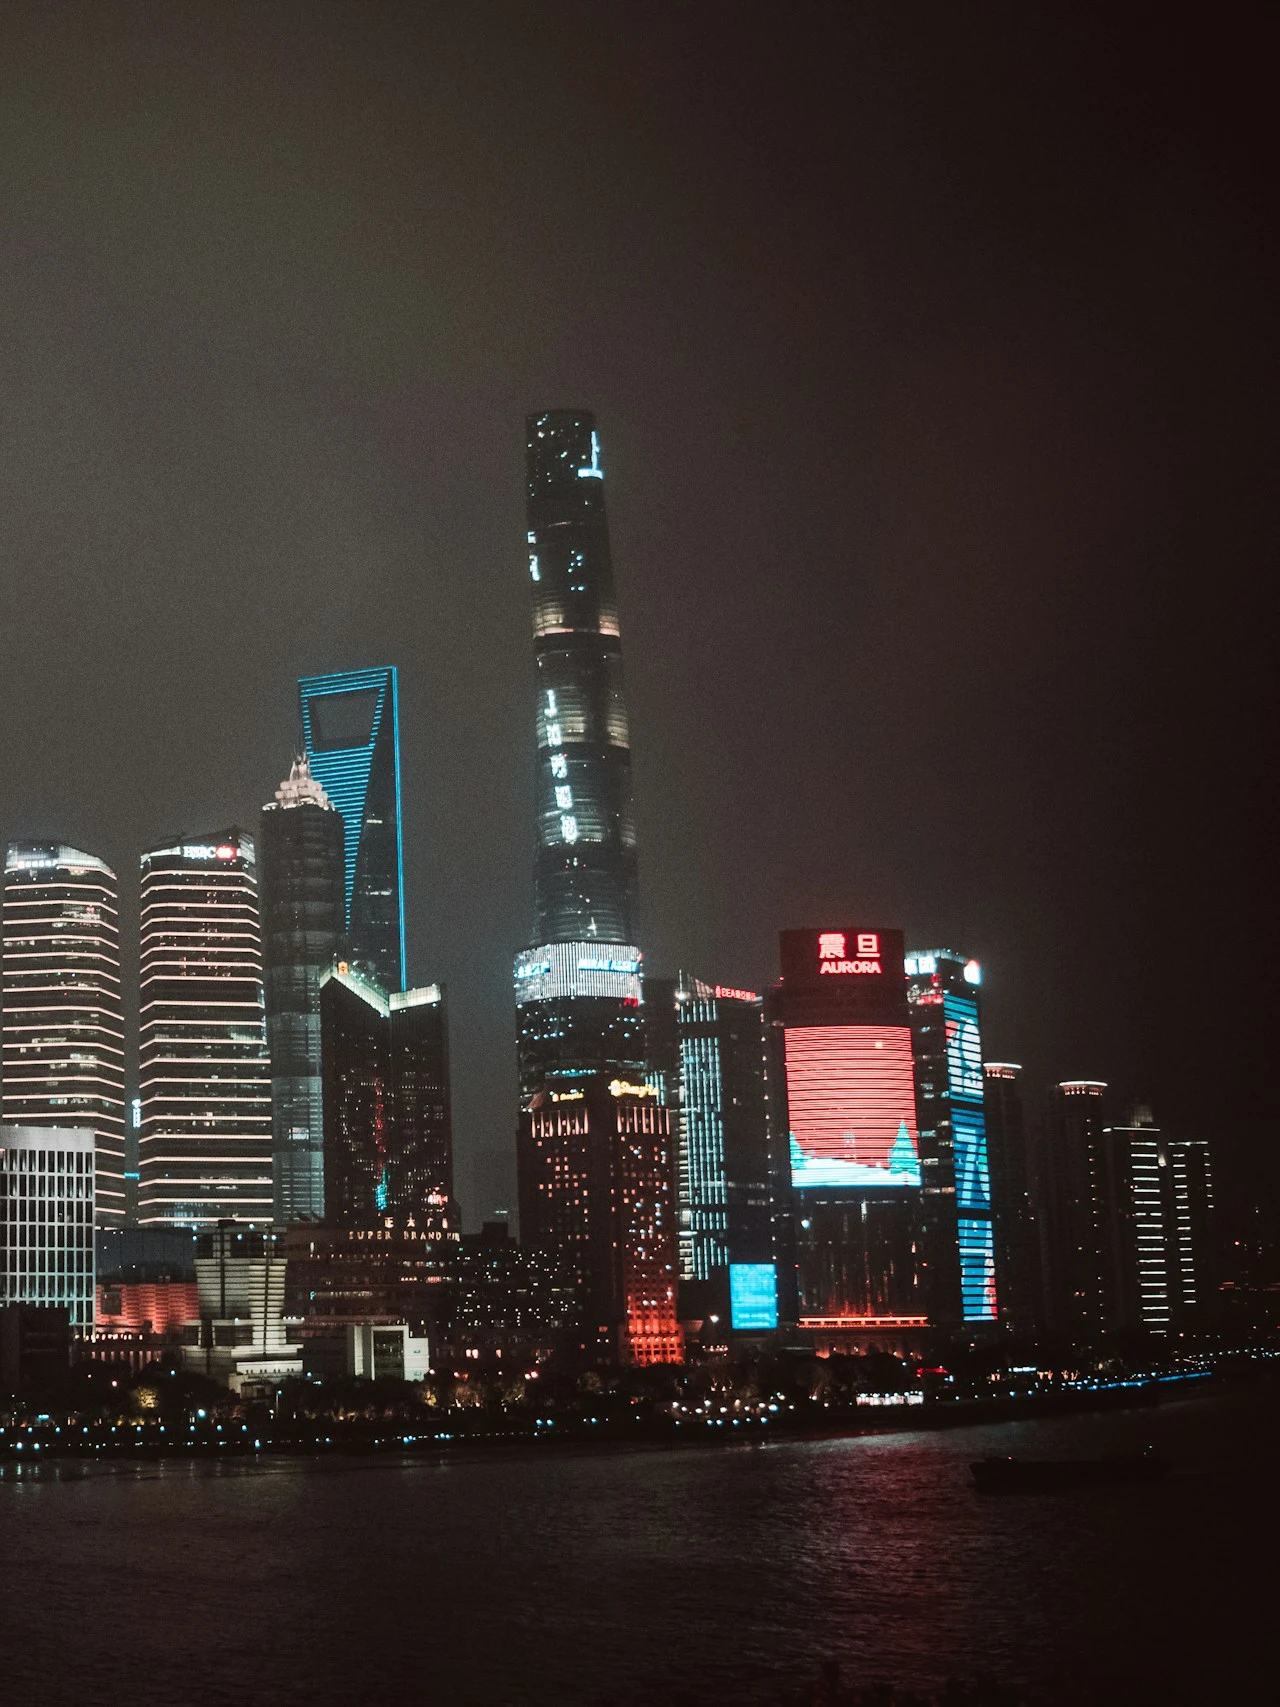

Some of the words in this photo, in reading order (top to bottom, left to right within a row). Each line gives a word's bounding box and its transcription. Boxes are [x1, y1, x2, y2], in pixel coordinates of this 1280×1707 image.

[182, 846, 216, 859] HSBC
[818, 933, 881, 959] 震旦
[820, 961, 882, 975] AURORA
[348, 1230, 392, 1241] SUPER
[404, 1230, 442, 1241] BRAND
